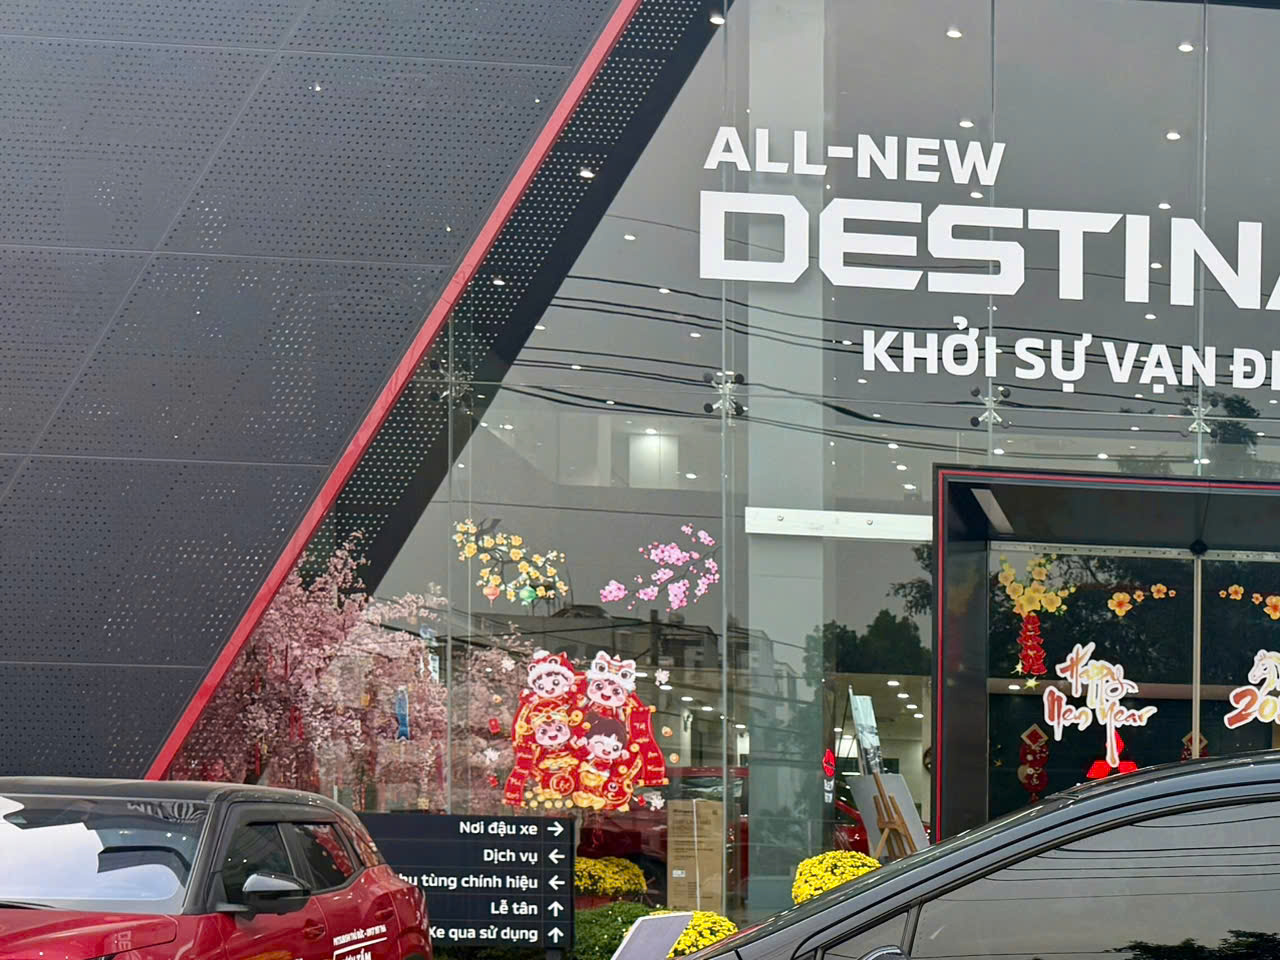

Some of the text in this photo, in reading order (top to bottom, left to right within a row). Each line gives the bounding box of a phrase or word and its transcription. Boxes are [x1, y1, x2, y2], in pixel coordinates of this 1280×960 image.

[703, 126, 1006, 186] ALL-NEW
[862, 315, 997, 378] KHỞI
[1014, 333, 1092, 393] SỰ
[1101, 341, 1216, 394] VẠN
[459, 821, 538, 837] Nơi đậu xe
[483, 849, 538, 865] Dịch vụ
[421, 873, 457, 890] tùng
[461, 873, 502, 888] chính
[506, 874, 538, 891] hiệu
[490, 899, 538, 915] Lễ tân
[429, 925, 538, 942] Xe qua sử dụng
